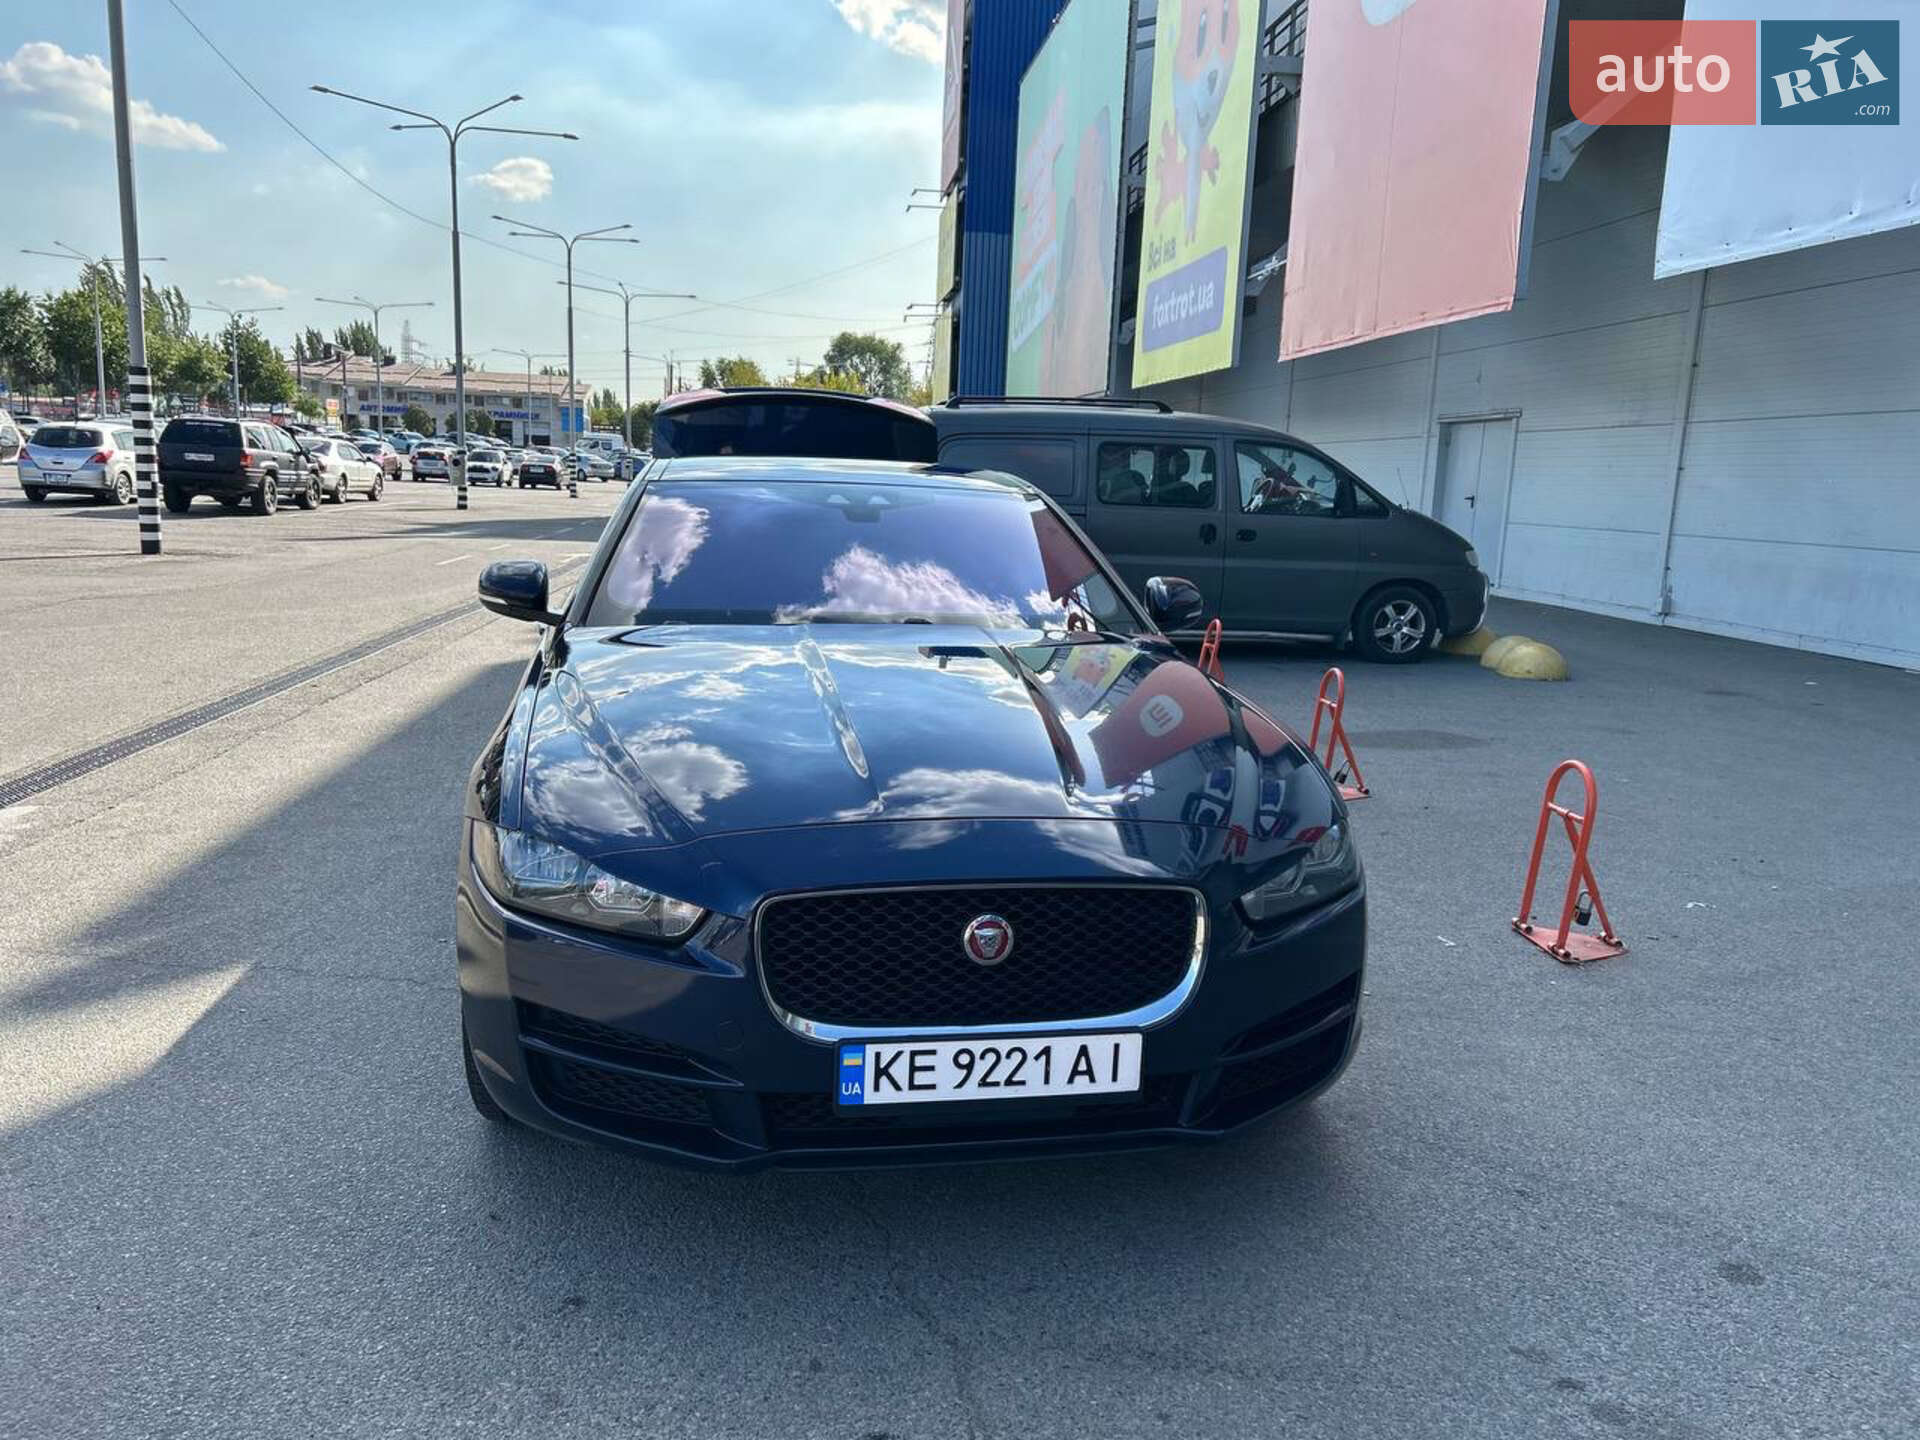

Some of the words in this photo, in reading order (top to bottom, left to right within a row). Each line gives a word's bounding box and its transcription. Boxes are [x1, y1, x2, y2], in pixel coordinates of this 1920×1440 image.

[1152, 280, 1215, 329] foxtrot.ua
[842, 1082, 862, 1096] UA
[873, 1049, 937, 1093] KE
[952, 1045, 1052, 1090] 9221
